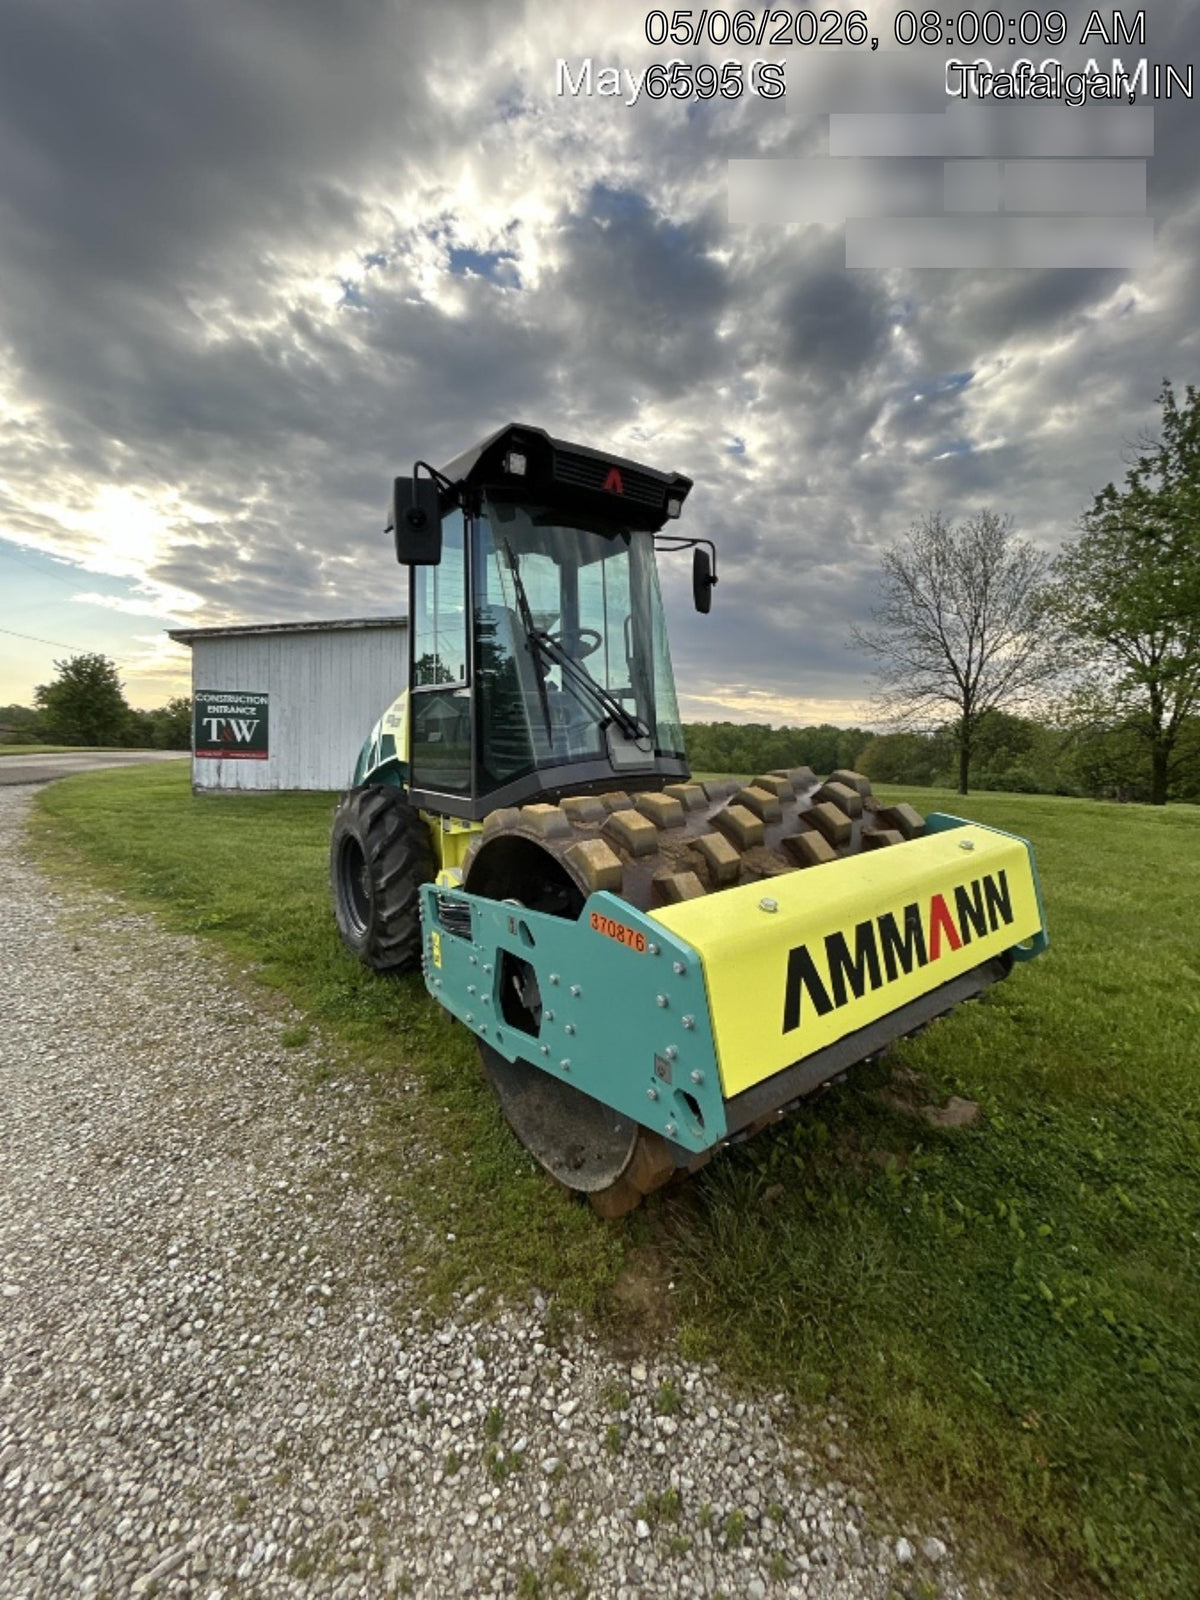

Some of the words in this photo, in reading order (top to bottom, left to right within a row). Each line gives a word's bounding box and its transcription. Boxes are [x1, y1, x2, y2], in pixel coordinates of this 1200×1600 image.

[195, 693, 267, 705] CONSTRUCTION
[207, 705, 257, 715] ENTRANCE
[591, 913, 644, 952] 370876
[782, 869, 1014, 1035] AMMANN
